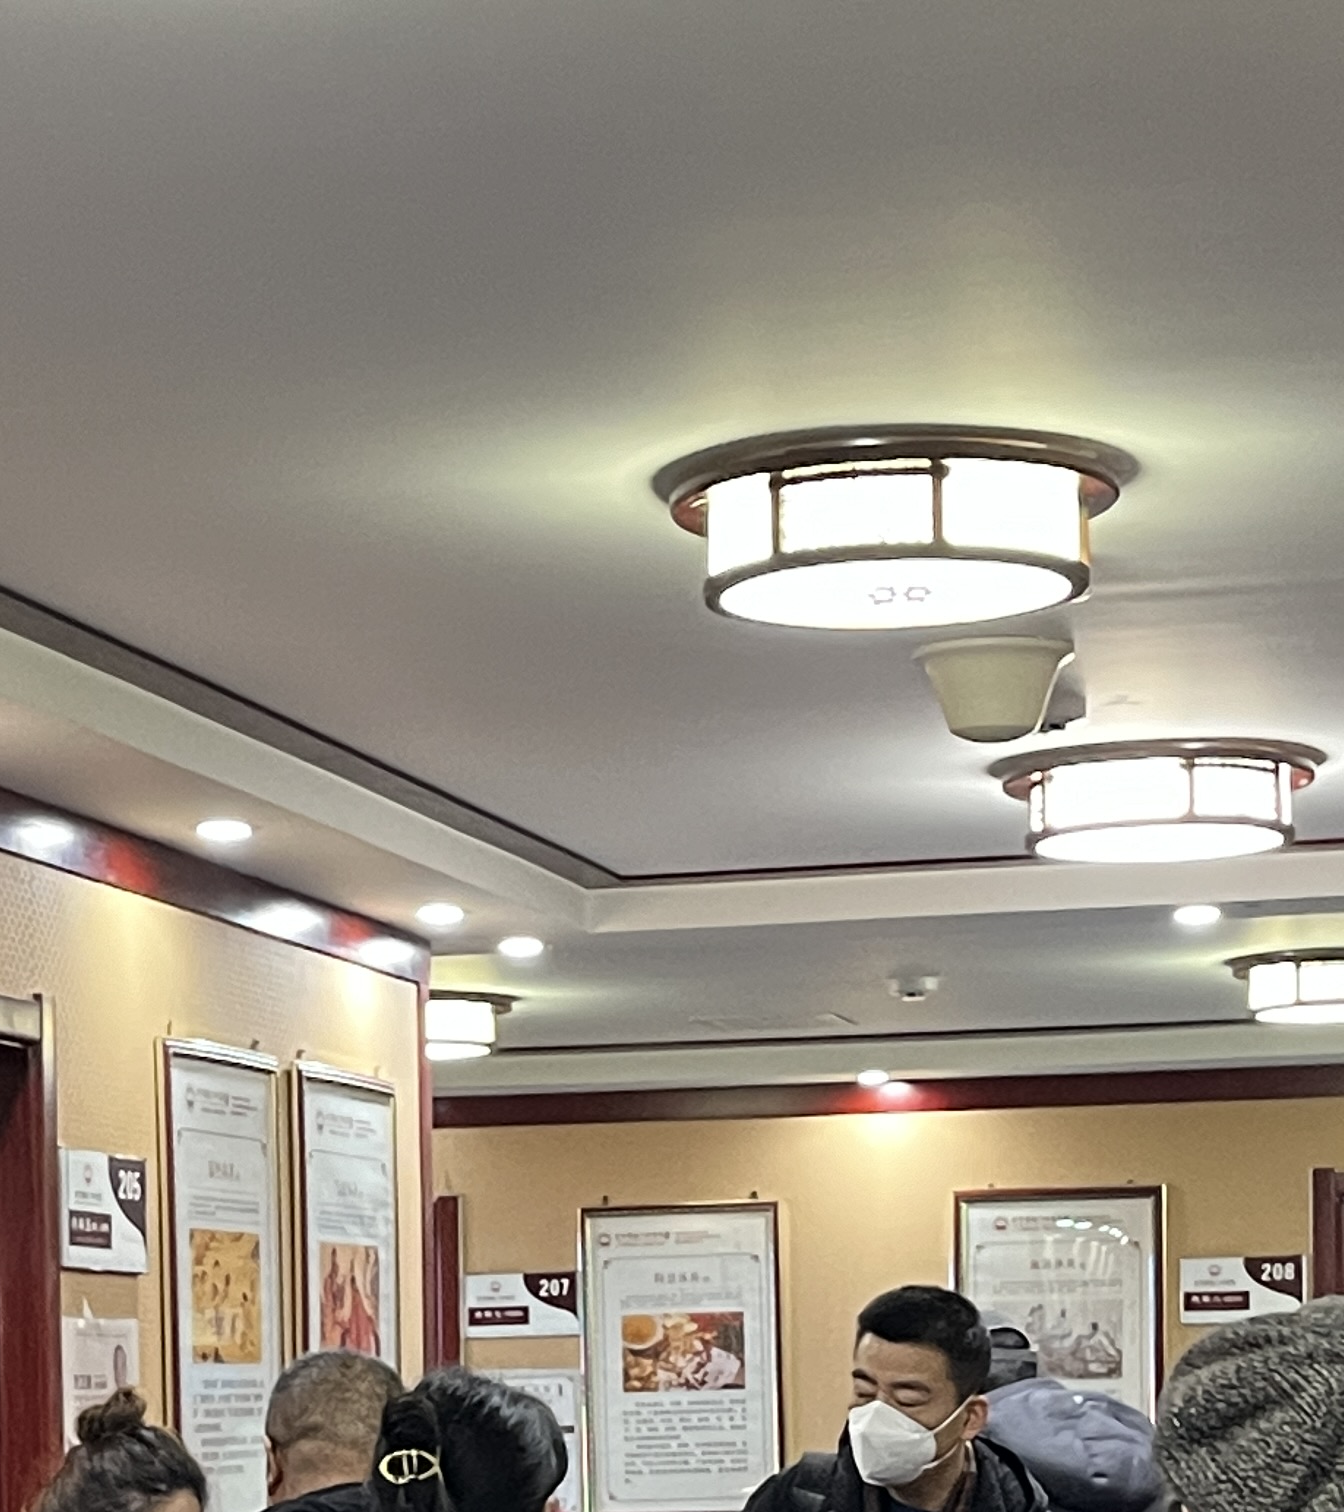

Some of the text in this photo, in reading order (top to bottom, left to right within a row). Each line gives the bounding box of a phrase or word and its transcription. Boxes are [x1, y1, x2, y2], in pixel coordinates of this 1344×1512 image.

[118, 1169, 142, 1201] 205
[1260, 1262, 1296, 1281] 208
[538, 1278, 570, 1297] 207
